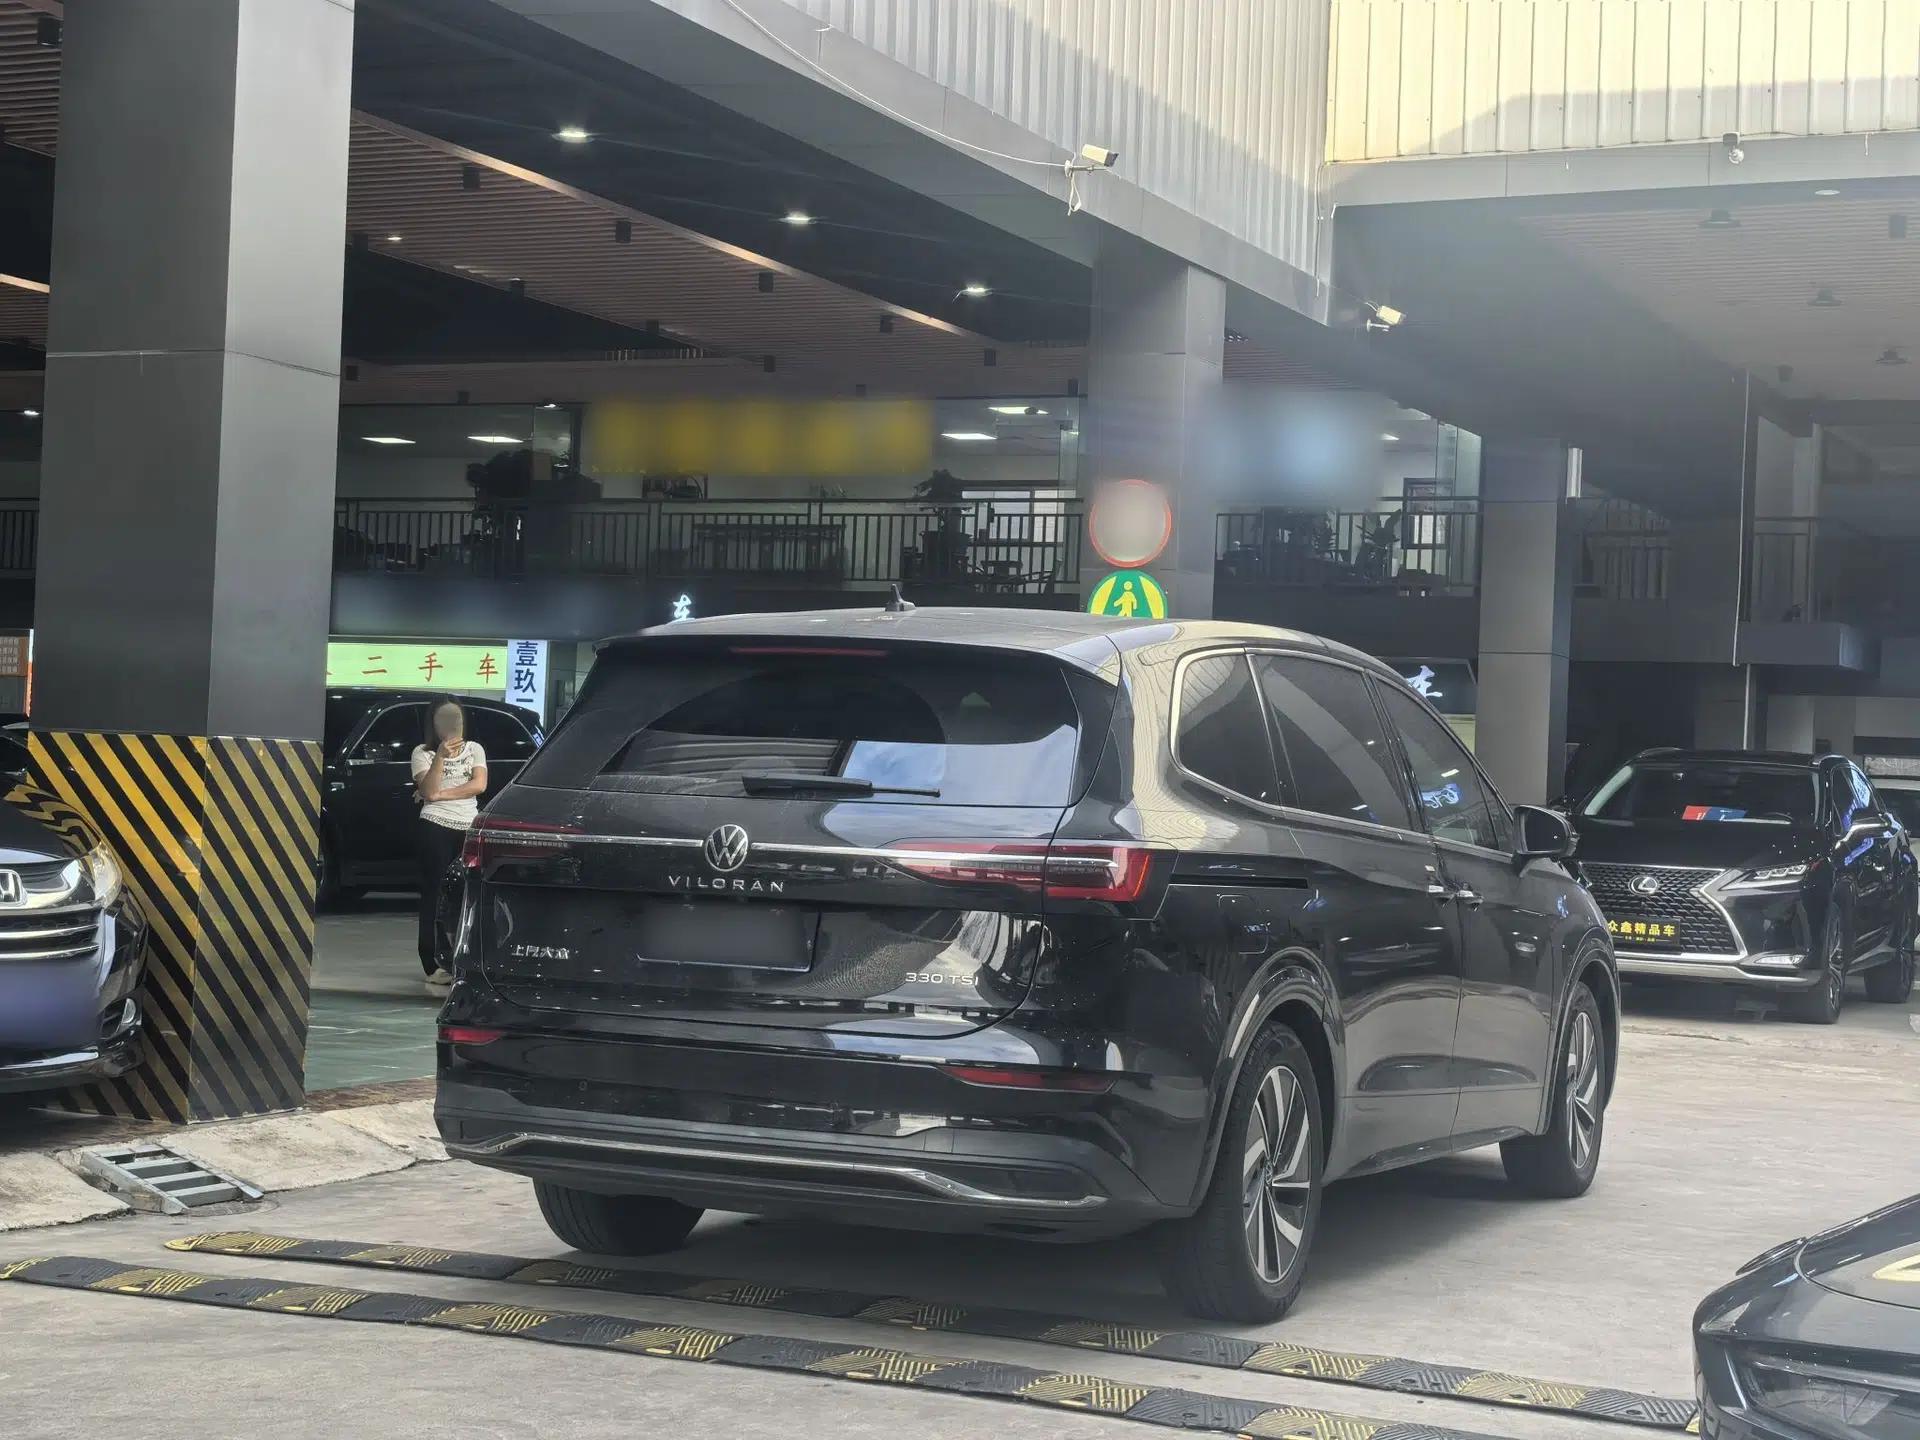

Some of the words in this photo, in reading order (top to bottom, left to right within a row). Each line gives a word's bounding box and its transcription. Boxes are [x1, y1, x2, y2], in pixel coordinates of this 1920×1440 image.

[328, 652, 498, 684] 二手车
[668, 875, 784, 893] VILORAN
[905, 972, 943, 984] 330
[948, 975, 979, 986] TSI
